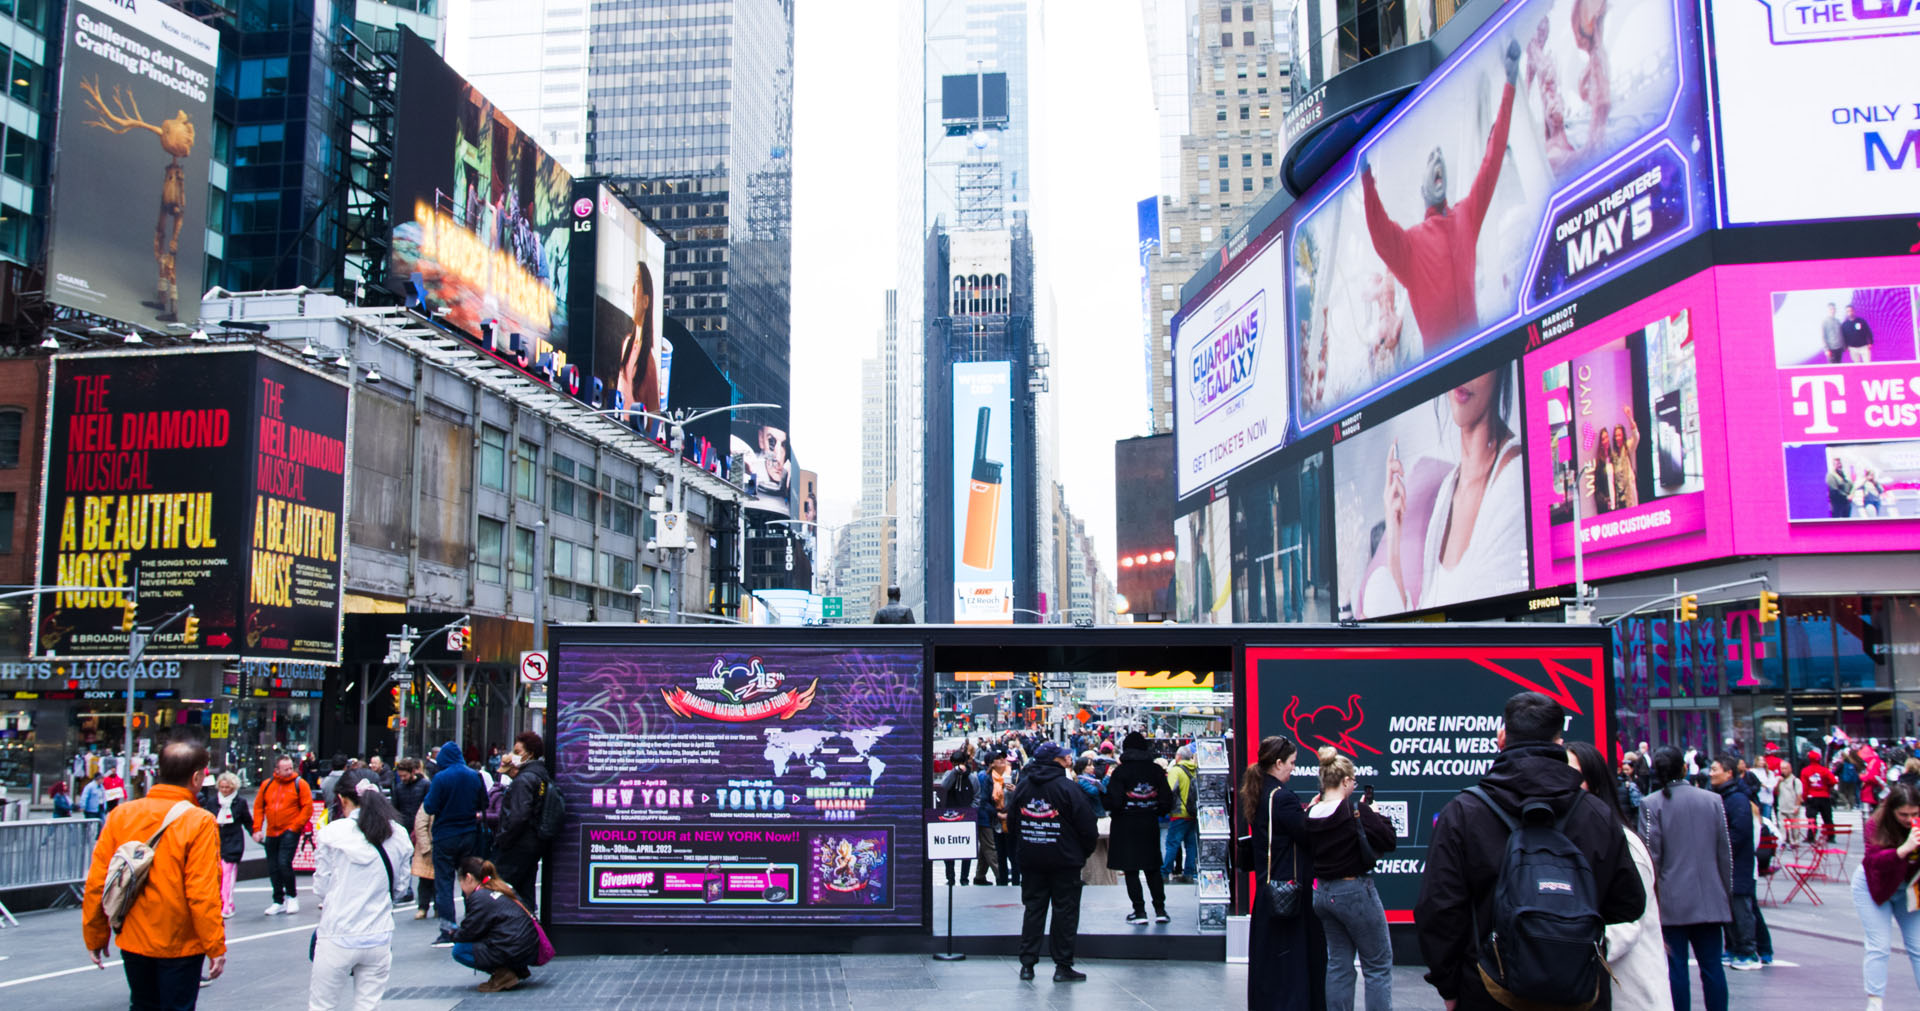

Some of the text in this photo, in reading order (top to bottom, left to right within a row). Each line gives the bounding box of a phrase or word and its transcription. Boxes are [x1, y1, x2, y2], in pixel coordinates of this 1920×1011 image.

[1796, 4, 1847, 24] THE
[161, 20, 210, 51] Now on view
[76, 13, 208, 88] Guillermo del Toro:
[75, 31, 207, 103] Crafting Pinocchio
[1287, 86, 1327, 127] MARRIOTT
[1832, 104, 1900, 124] ONLY
[1556, 166, 1662, 241] ONLY IN THEATERS
[575, 221, 591, 232] LG
[1567, 194, 1653, 276] MAY 5
[1542, 303, 1577, 328] MARRIOTT
[1542, 318, 1575, 341] MARQUIS
[1193, 308, 1258, 383] GUARDIANS
[1207, 342, 1256, 403] GALAXY
[73, 375, 110, 413] THE
[263, 378, 285, 420] THE
[1578, 364, 1593, 416] NYC
[1862, 379, 1906, 401] WE
[1791, 374, 1847, 434] T
[69, 409, 230, 451] NEIL DIAMOND
[260, 417, 345, 475] NEIL DIAMOND
[1192, 417, 1268, 474] GET TICKETS NOW
[65, 451, 153, 492] MUSICAL
[257, 453, 306, 501] MUSICAL
[1584, 457, 1597, 497] WE
[59, 492, 217, 551] A BEAUTIFUL
[253, 495, 337, 562] A BEAUTIFUL
[1601, 523, 1619, 539] OUR
[1619, 509, 1671, 537] CUSTOMERS
[140, 571, 155, 579] THE
[182, 570, 211, 578] YOU'VE
[202, 558, 229, 566] KNOW.
[55, 552, 132, 609] NOISE
[251, 550, 294, 608] NOISE
[1529, 596, 1560, 610] SEPHORA
[70, 633, 150, 643] & BROADHUT
[70, 661, 181, 679] LUGGAGE
[278, 662, 326, 680] LUGGAGE
[84, 691, 115, 699] SONY
[682, 690, 791, 716] TAMASHII NATIONS WORLD TOUR
[1389, 716, 1506, 733] MORE INFORM
[1390, 738, 1502, 754] OFFCIAL WEBS
[1390, 760, 1421, 776] SNS
[592, 788, 694, 808] NEW YORK
[716, 789, 785, 810] TOKYO
[815, 799, 866, 811] SHANGHAI
[825, 810, 856, 821] PARIS
[590, 830, 800, 842] WORLD TOUR at NEW YORK Now!!
[934, 834, 971, 847] No Entry
[1373, 859, 1419, 874] CHECK
[601, 871, 654, 888] Giveaways
